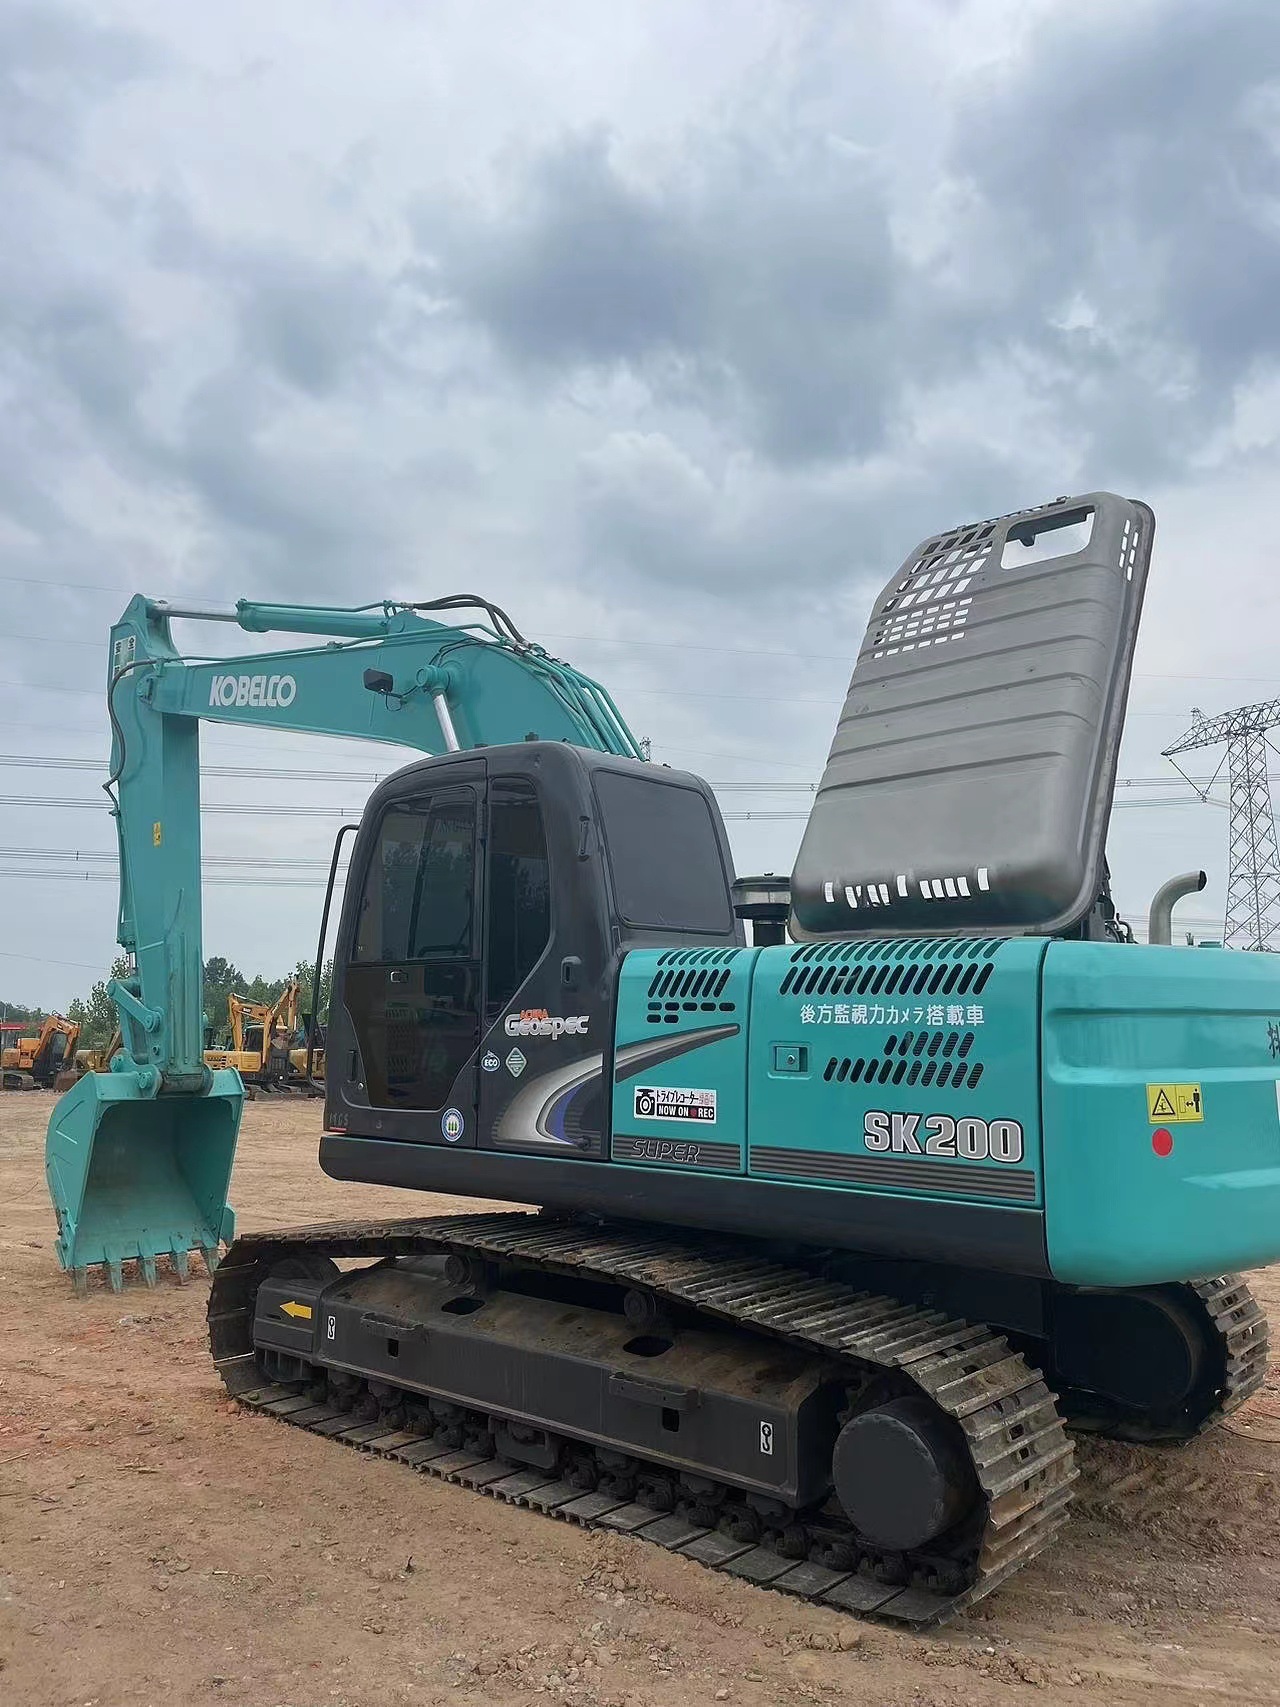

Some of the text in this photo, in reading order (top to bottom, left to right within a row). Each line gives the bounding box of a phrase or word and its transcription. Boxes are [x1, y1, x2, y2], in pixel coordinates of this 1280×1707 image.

[209, 675, 296, 707] KOBELCO
[504, 1013, 590, 1041] Geospec
[484, 1058, 498, 1067] ECO
[658, 1105, 714, 1119] NOW ON REC
[864, 1109, 1024, 1164] SK200
[631, 1138, 701, 1164] SUPER
